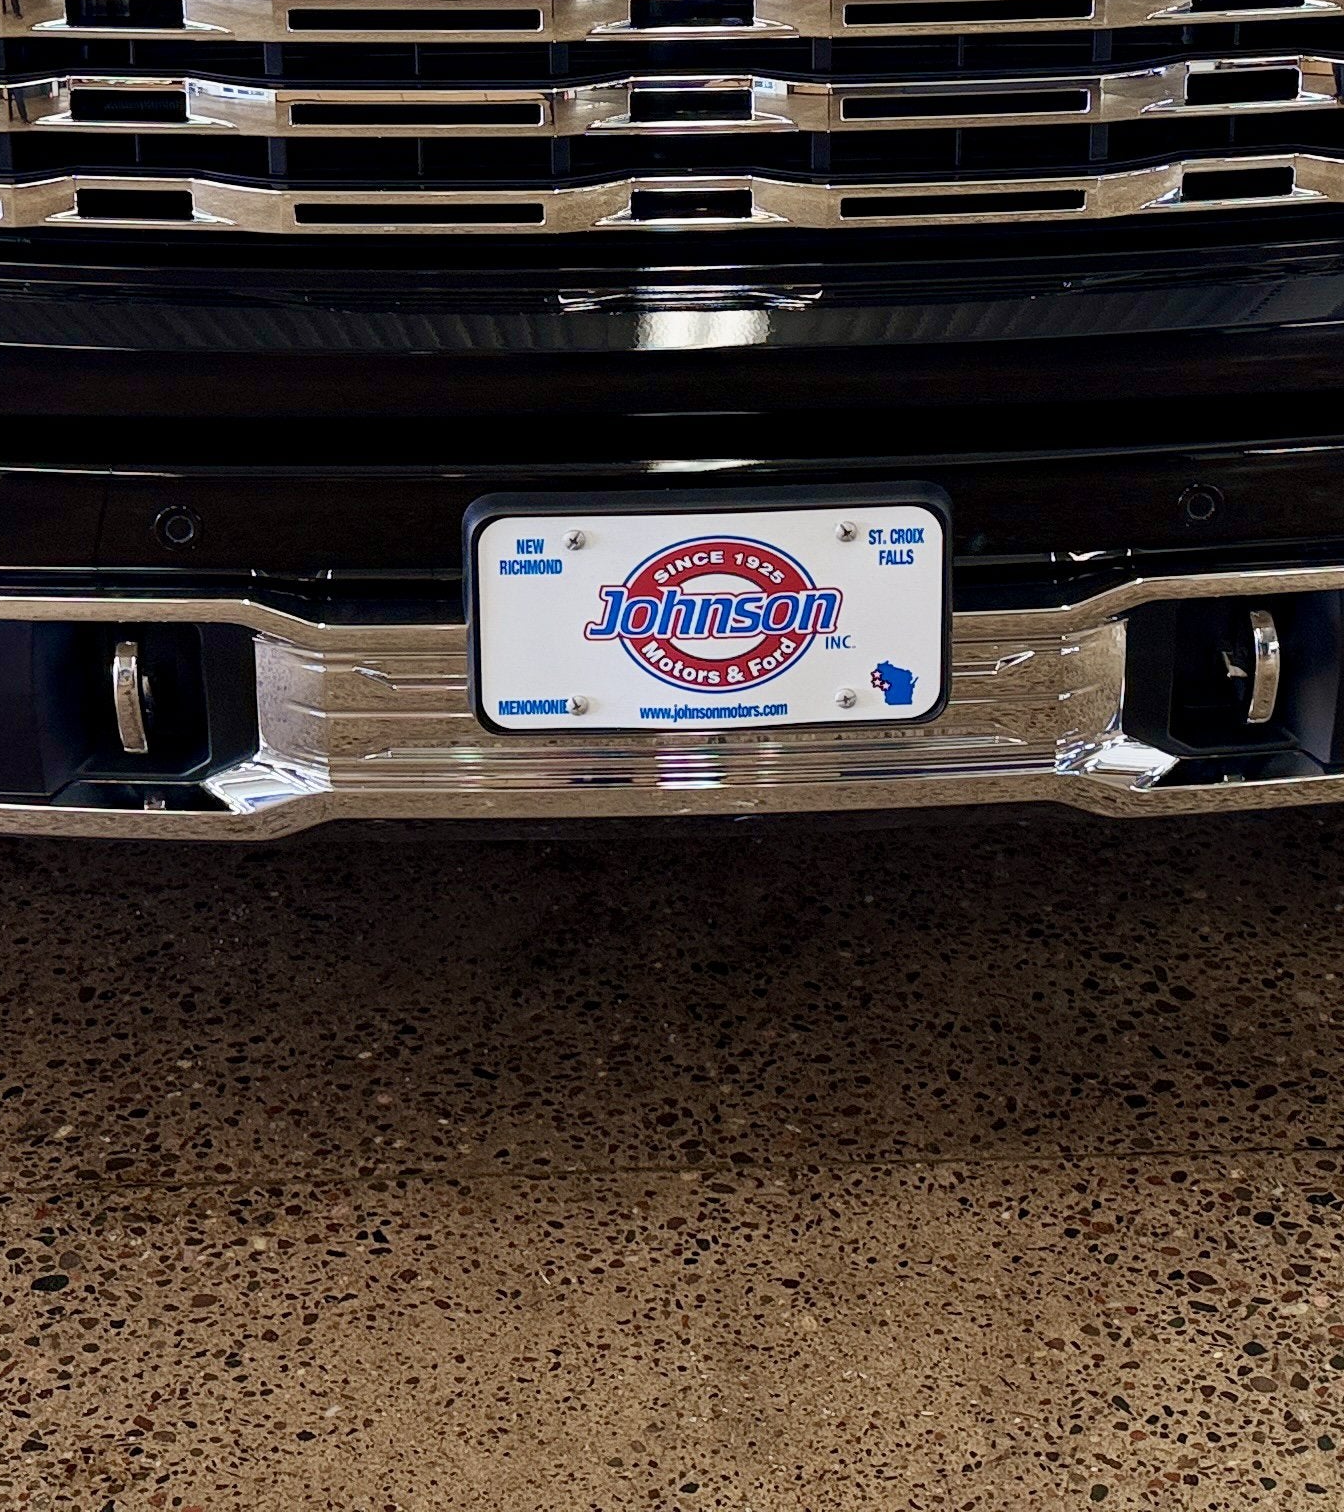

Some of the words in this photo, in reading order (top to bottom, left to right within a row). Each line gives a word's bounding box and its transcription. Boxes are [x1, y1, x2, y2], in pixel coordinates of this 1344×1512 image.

[868, 529, 887, 545] ST.
[890, 528, 925, 544] CROIX
[516, 538, 545, 555] NEW
[878, 549, 914, 565] FALLS
[499, 559, 563, 575] RICHMOND
[653, 550, 725, 584] SINCE
[733, 552, 786, 584] 1925
[588, 588, 839, 638] Johnson
[641, 640, 721, 684] Motors
[726, 665, 749, 684] &
[748, 636, 798, 677] Ford
[498, 699, 569, 715] MENOMONIE
[639, 702, 788, 723] www.johnsonmotors.com
